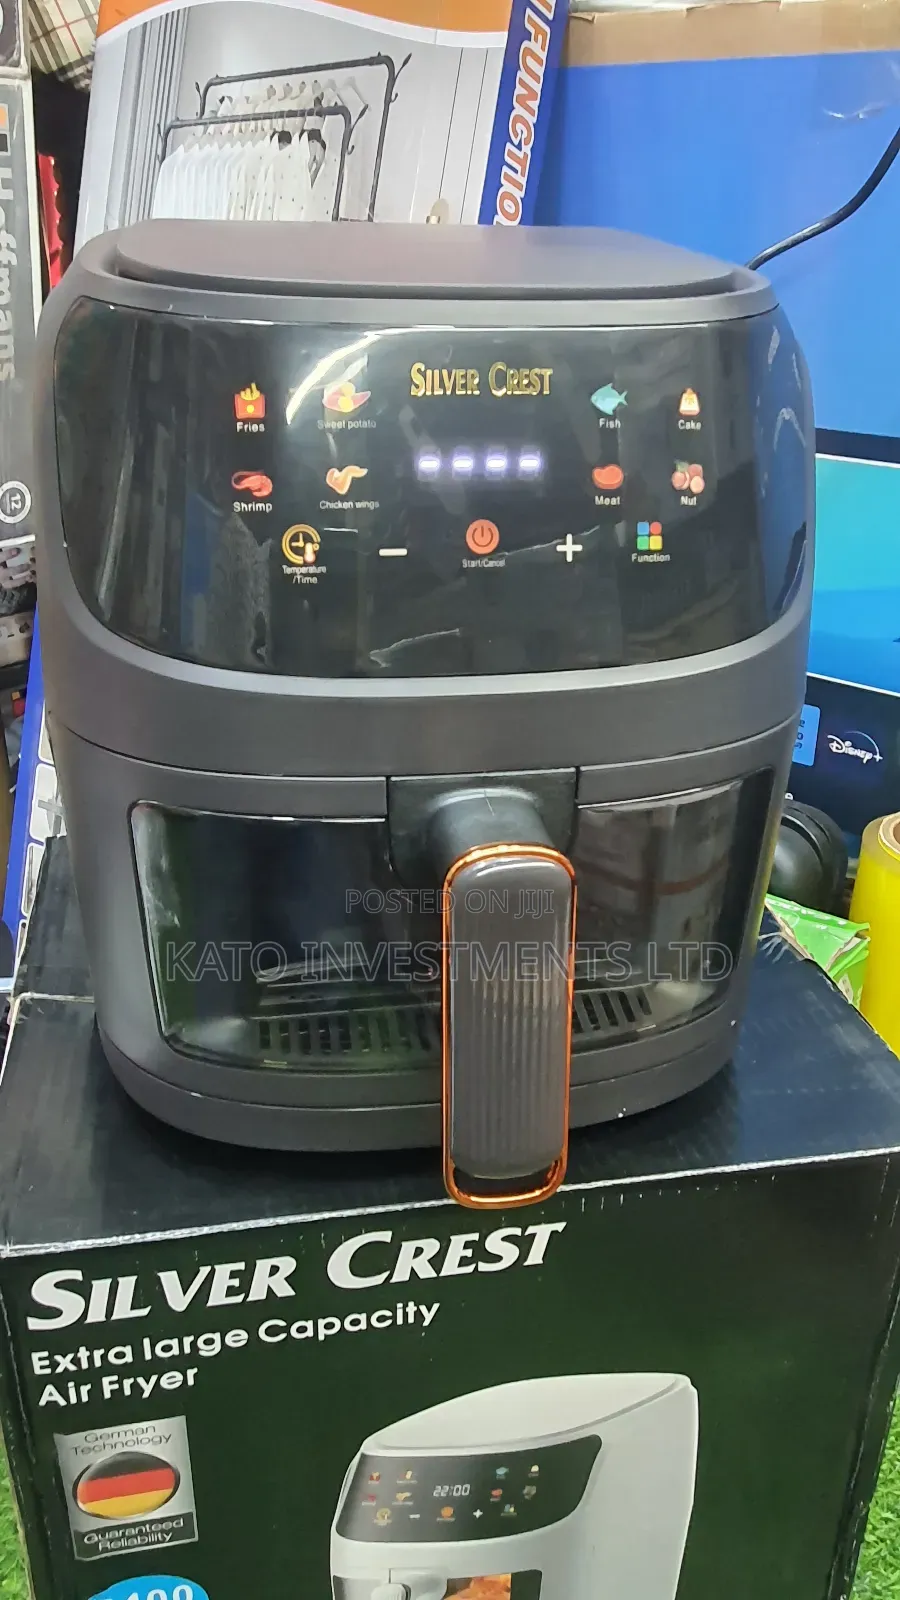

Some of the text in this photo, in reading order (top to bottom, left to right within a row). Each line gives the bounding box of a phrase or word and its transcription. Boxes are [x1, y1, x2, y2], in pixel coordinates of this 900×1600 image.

[493, 8, 551, 225] FUNCTIO
[410, 362, 553, 397] SILVER CREST
[236, 422, 265, 433] Fries
[317, 420, 377, 430] Sweet potato
[599, 418, 621, 429] Fish
[678, 419, 702, 430] Cake
[233, 502, 272, 513] Shrimp
[319, 500, 380, 510] Chicken wings
[595, 496, 621, 506] Meat
[680, 496, 697, 506] Nut
[631, 553, 670, 563] Function
[282, 564, 327, 575] Temperature
[27, 1221, 567, 1331] SILVER CREST
[31, 1302, 441, 1376] Extra large Capacity
[37, 1368, 199, 1407] Air Fryer
[84, 1425, 156, 1444] German
[72, 1434, 172, 1456] Technology
[433, 1483, 471, 1498] 22:00
[84, 1518, 184, 1545] Guaranteed
[98, 1532, 173, 1552] Reliability
